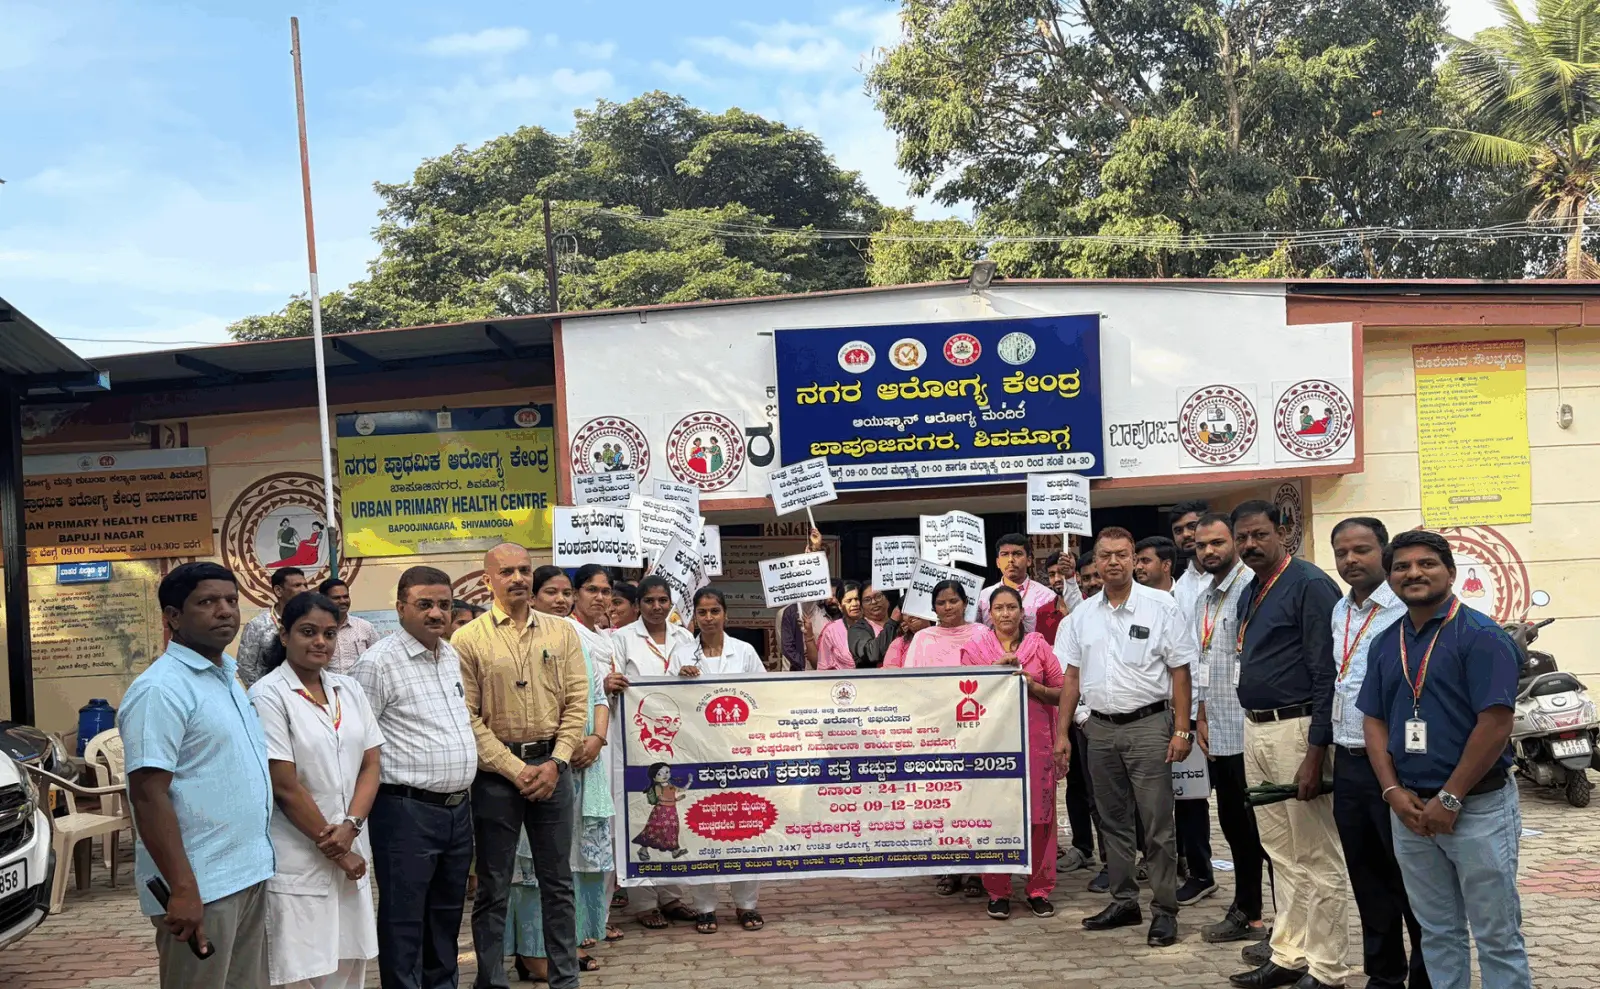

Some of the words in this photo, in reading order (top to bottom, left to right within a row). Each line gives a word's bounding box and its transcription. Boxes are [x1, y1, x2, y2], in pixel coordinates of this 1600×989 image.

[796, 380, 862, 405] ನಗರ
[877, 373, 989, 407] ಆರೋಗ್ಯ
[1002, 368, 1081, 398] ಕೇಂದ್ರ
[852, 414, 920, 432] ಆಯುಷ್ಮಾನ್
[924, 411, 977, 428] ಆರೋಗ್ಯ
[981, 406, 1026, 421] ಮಂದಿರ
[809, 432, 961, 458] ಬಾಪೂಜಿನಗರ,
[973, 426, 1071, 451] ಶಿವಮೊಗ್ಗ
[344, 456, 377, 475] ನಗರ
[384, 452, 440, 480] ಪ್ರಾಥಮಿಕ
[448, 448, 505, 478] ಆರೋಗ್ಯ
[510, 445, 549, 473] ಕೇಂದ್ರ
[845, 469, 869, 478] 09-00
[871, 466, 889, 477] ರಿಂದ
[890, 464, 919, 479] ಮಧ್ಯಾಹ್ನ
[921, 464, 943, 474] 01-00
[945, 461, 967, 472] ಹಾಗೂ
[970, 460, 999, 475] ಮಧ್ಯಾಹ್ನ
[1001, 460, 1024, 469] 02-00
[1027, 458, 1043, 468] ರಿಂದ
[1047, 455, 1064, 467] ಸಂಜೆ
[1067, 456, 1090, 465] 04-30
[54, 478, 73, 488] ಮತ್ತು
[76, 475, 106, 485] ಕುಟುಂಬ
[110, 474, 137, 486] ಕಲ್ಯಾಣ
[169, 470, 203, 481] ಶಿವಮೊಗ್ಗ
[390, 481, 463, 493] ಬಾಪೂಜಿನಗರ,
[467, 478, 505, 492] ಶಿವಮೊಗ್ಗ
[615, 472, 636, 482] ಮತ್ತು
[69, 492, 109, 511] ಆರೋಗ್ಯ
[113, 490, 141, 507] ಕೇಂದ್ರ
[146, 488, 207, 501] ಬಾಪೂಜಿನಗರ
[351, 500, 392, 518] URBAN
[395, 497, 449, 516] PRIMARY
[452, 495, 497, 513] HEALTH
[501, 492, 547, 510] CENTRE
[48, 518, 99, 530] PRIMARY
[103, 516, 148, 527] HEALTH
[151, 513, 198, 524] CENTRE
[388, 521, 458, 533] BAPOOJINAGARA,
[461, 518, 514, 529] SHIVAMOGGA
[571, 509, 626, 534] ಕುಷ್ಠರೋಗವು
[59, 532, 100, 543] BAPUJI
[104, 530, 145, 541] NAGAR
[61, 546, 86, 556] 09.00
[768, 560, 795, 572] M.D.T
[823, 716, 863, 727] ಆರೋಗ್ಯ
[867, 714, 911, 724] ಅಭಿಯಾನ
[956, 721, 981, 729] NLEP
[769, 730, 800, 741] ಆರೋಗ್ಯ
[805, 730, 824, 740] ಮತ್ತು
[827, 728, 857, 738] ಕುಟುಂಬ
[861, 728, 886, 739] ಕಲ್ಯಾಣ
[916, 725, 940, 734] ಹಾಗೂ
[731, 745, 752, 757] ಜಿಲ್ಲಾ
[920, 737, 957, 749] ಶಿವಮೊಗ್ಗ
[698, 762, 770, 788] ಕುಷ್ಠರೋಗ
[775, 760, 822, 783] ಪ್ರಕರಣ
[828, 759, 852, 781] ಪತ್ತೆ
[858, 759, 898, 782] ಹಚ್ಚುವ
[903, 756, 1018, 776] ಅಭಿಯಾನ-2025
[817, 784, 862, 797] ದಿನಾಂಕ
[878, 781, 963, 795] 24-11-2025
[829, 801, 857, 813] ರಿಂದ
[863, 798, 952, 812] 09-12-2025
[868, 819, 906, 832] ಉಚಿತ
[912, 816, 945, 834] ಚಿಕಿತ್ಸೆ
[951, 818, 993, 829] ಉಂಟು
[726, 844, 774, 855] ಮಾಹಿತಿಗಾಗಿ
[806, 841, 832, 851] ಉಚಿತ
[835, 838, 871, 852] ಆರೋಗ್ಯ
[874, 837, 933, 849] ಸಹಾಯವಾಣಿ
[976, 836, 990, 846] ಕರೆ
[995, 835, 1022, 846] ಮಾಡಿ
[690, 861, 721, 873] ಆರೋಗ್ಯ
[724, 860, 742, 871] ಮತ್ತು
[745, 859, 773, 869] ಕುಟುಂಬ
[777, 857, 799, 870] ಕಲ್ಯಾಣ
[975, 851, 1005, 863] ಶಿವಮೊಗ್ಗ
